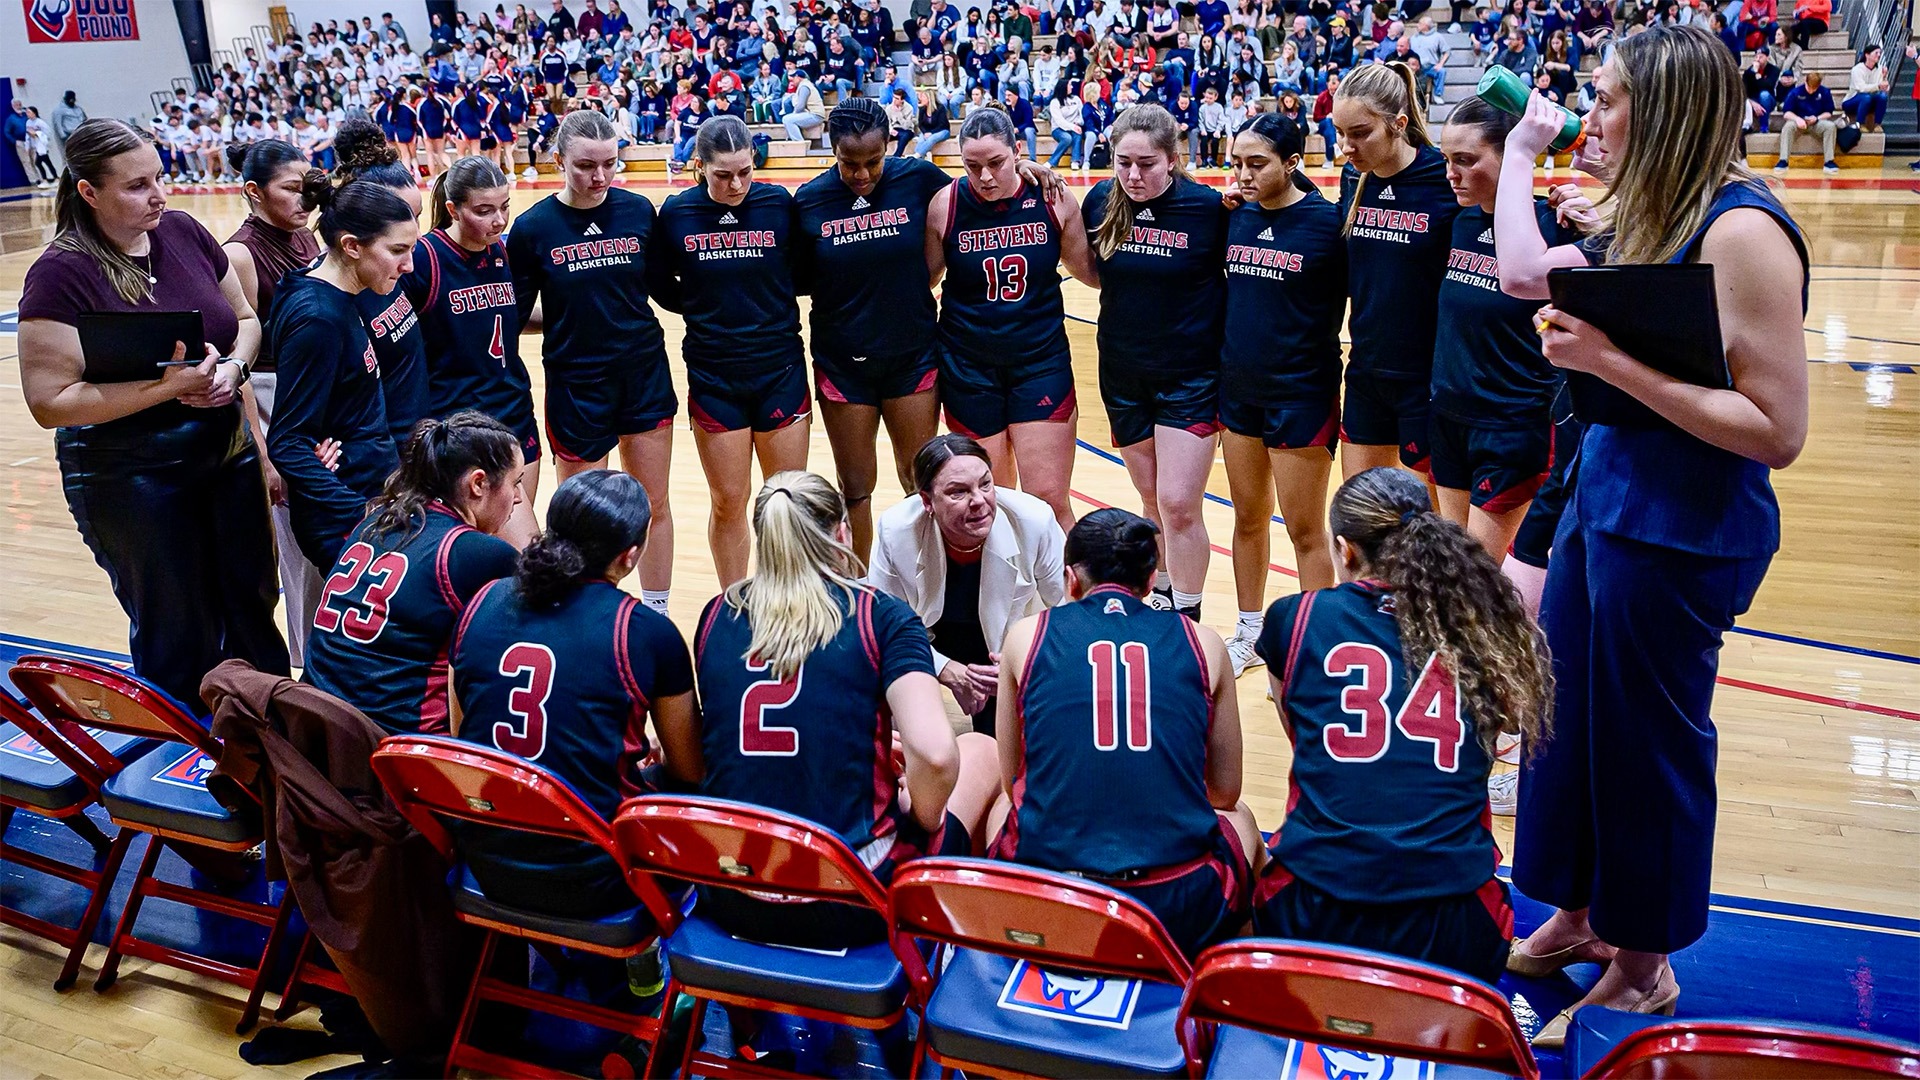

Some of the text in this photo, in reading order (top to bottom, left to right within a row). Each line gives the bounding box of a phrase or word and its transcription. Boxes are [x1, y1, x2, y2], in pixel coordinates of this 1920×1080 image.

[77, 16, 132, 38] POUND
[821, 207, 910, 238] STEVENS
[833, 226, 900, 246] BASKETBALL
[1352, 226, 1411, 244] BASKETBALL
[550, 237, 640, 265] STEVENS
[684, 230, 775, 252] STEVENS
[958, 222, 1048, 253] STEVENS
[1115, 243, 1173, 258] ASKETBALL
[567, 255, 632, 272] BASKETBALL
[699, 249, 764, 261] BASKETBALL
[1226, 244, 1304, 272] STEVENS
[1447, 248, 1500, 279] STEVEN
[982, 254, 1028, 302] 13
[1229, 263, 1285, 281] BASKETBALL
[1445, 269, 1498, 292] BASKETBALL
[488, 314, 507, 368] 4
[313, 541, 410, 644] 23
[492, 642, 556, 760] 3
[739, 648, 804, 757] 2
[1087, 640, 1152, 752] 11
[1323, 641, 1466, 773] 34
